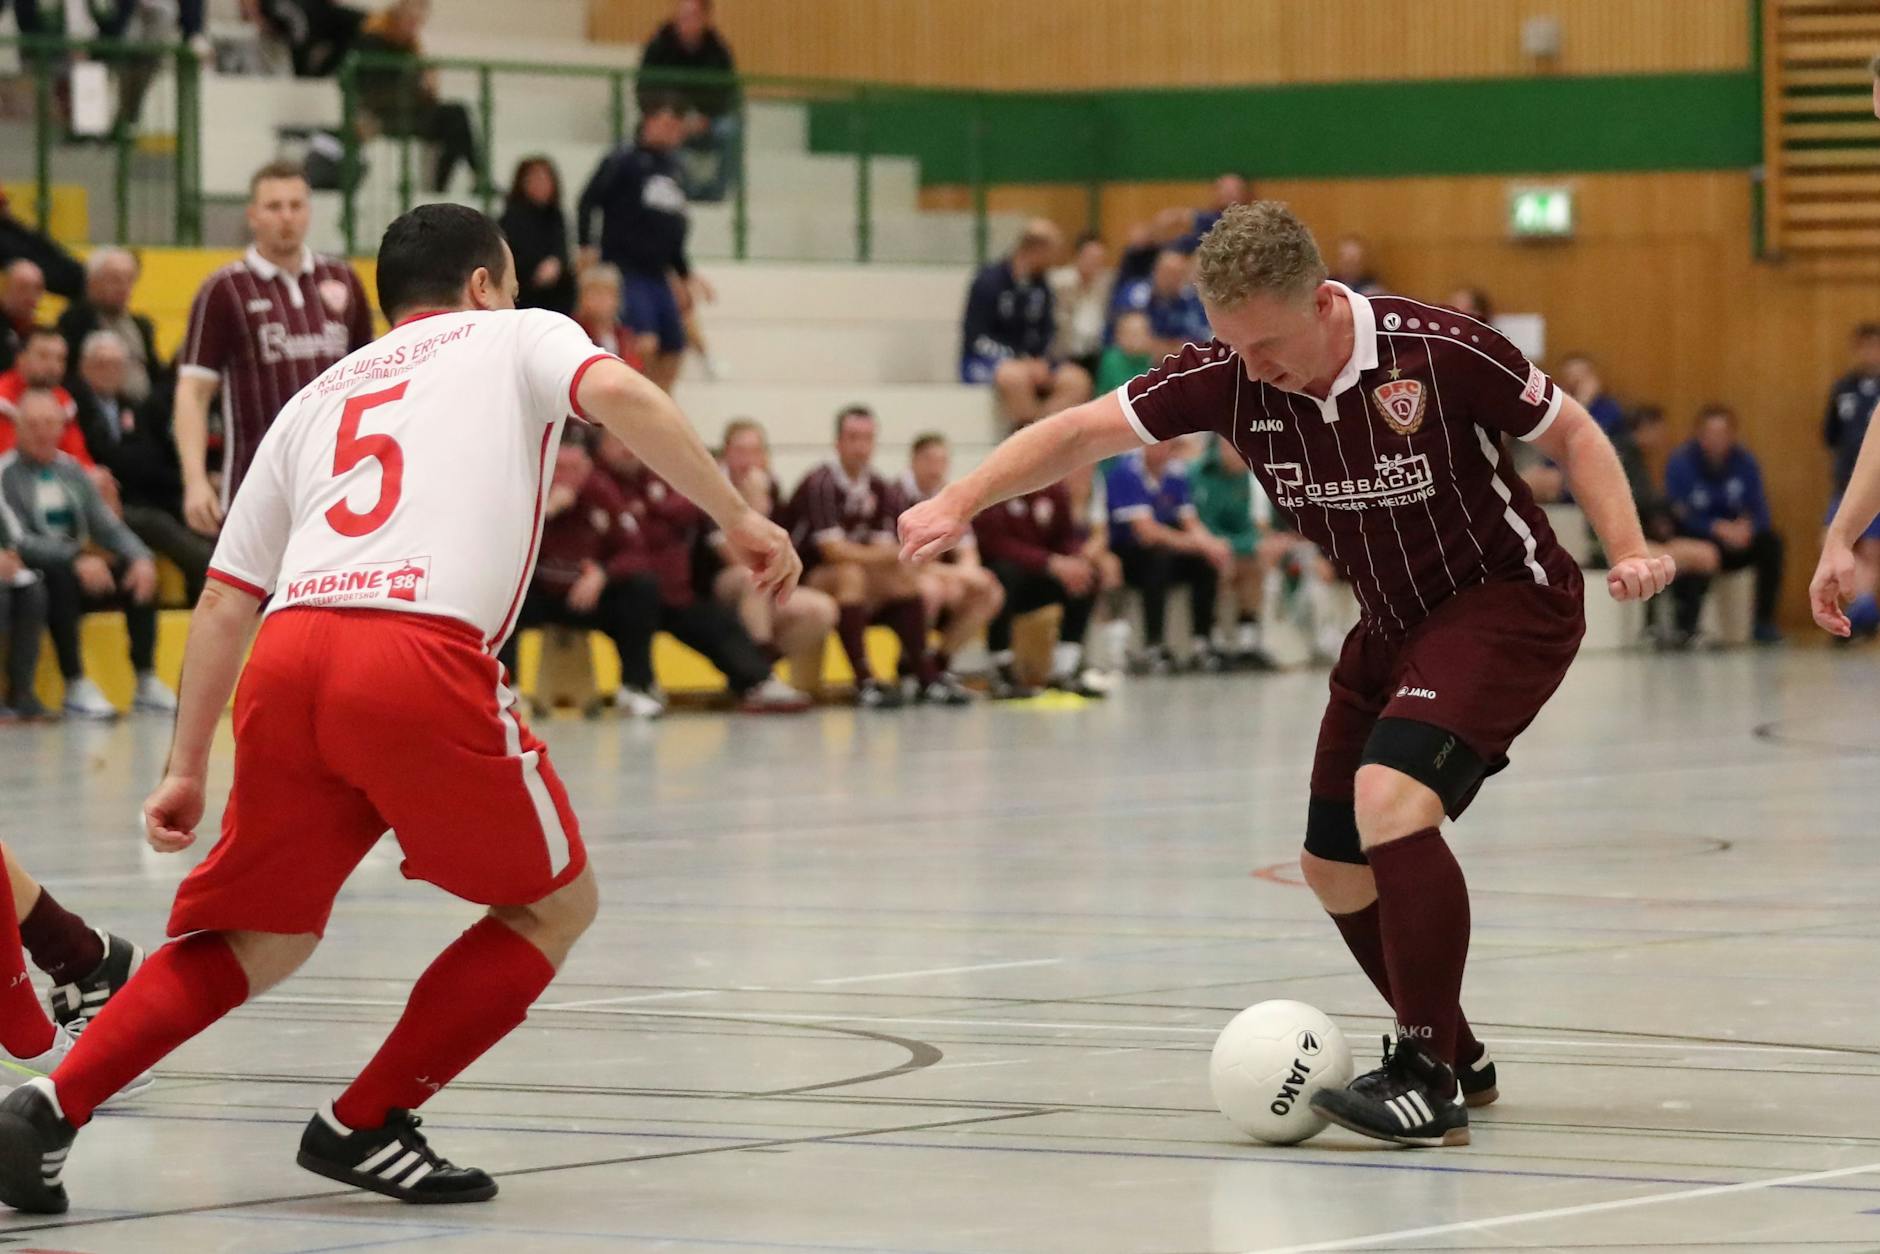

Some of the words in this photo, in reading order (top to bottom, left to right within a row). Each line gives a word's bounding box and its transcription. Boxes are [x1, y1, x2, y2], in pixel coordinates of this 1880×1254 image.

[412, 323, 476, 361] ERFURT
[1250, 419, 1284, 433] JAKO
[325, 379, 411, 537] 5
[1278, 497, 1304, 508] GAS
[1378, 486, 1436, 507] HEIZUNG
[393, 573, 416, 589] 38
[1408, 687, 1437, 700] JAKO
[1270, 1058, 1310, 1116] JAKO
